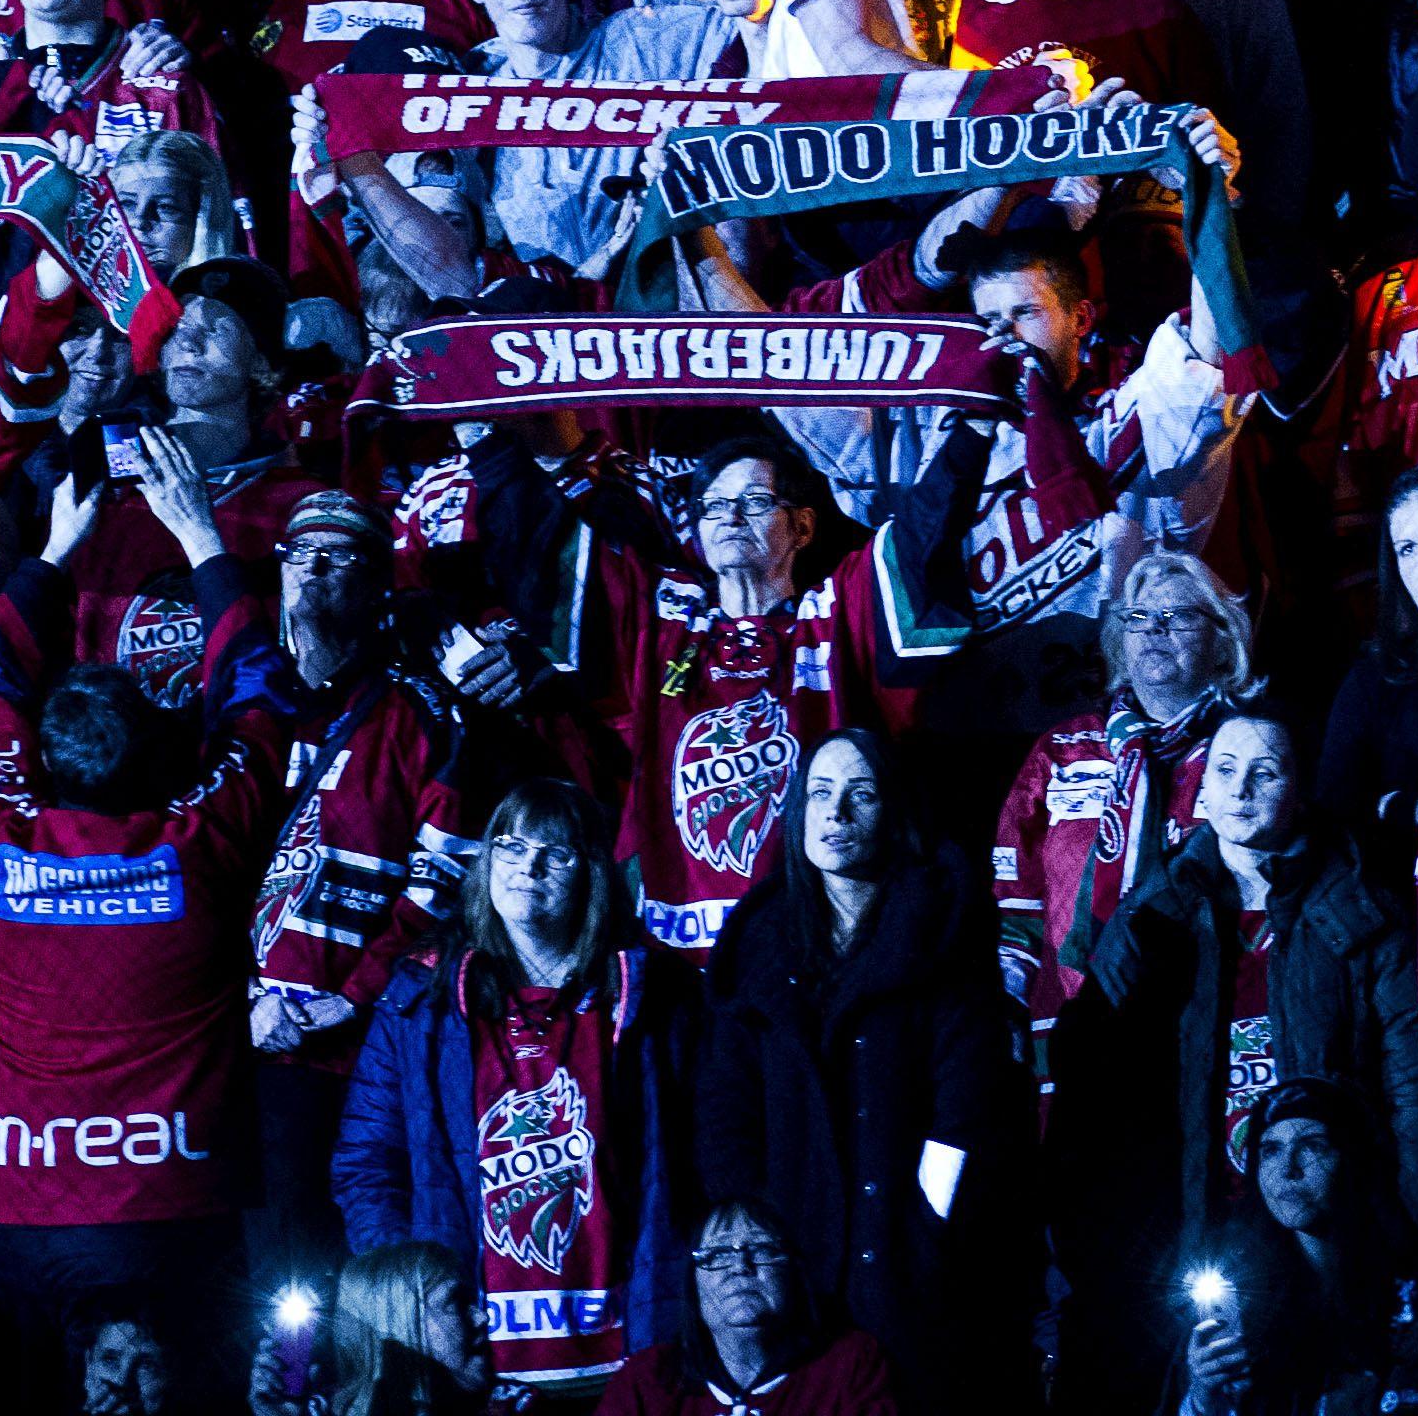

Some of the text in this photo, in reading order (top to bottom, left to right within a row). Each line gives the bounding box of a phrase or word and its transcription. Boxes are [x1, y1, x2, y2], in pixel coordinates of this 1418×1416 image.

[403, 95, 782, 136] OF HOCKEY
[657, 120, 891, 217] MODO
[492, 327, 944, 388] LUMBERJACKS
[683, 739, 786, 790] MODO
[6, 897, 173, 916] VEHICLE
[483, 1130, 587, 1186] MODO
